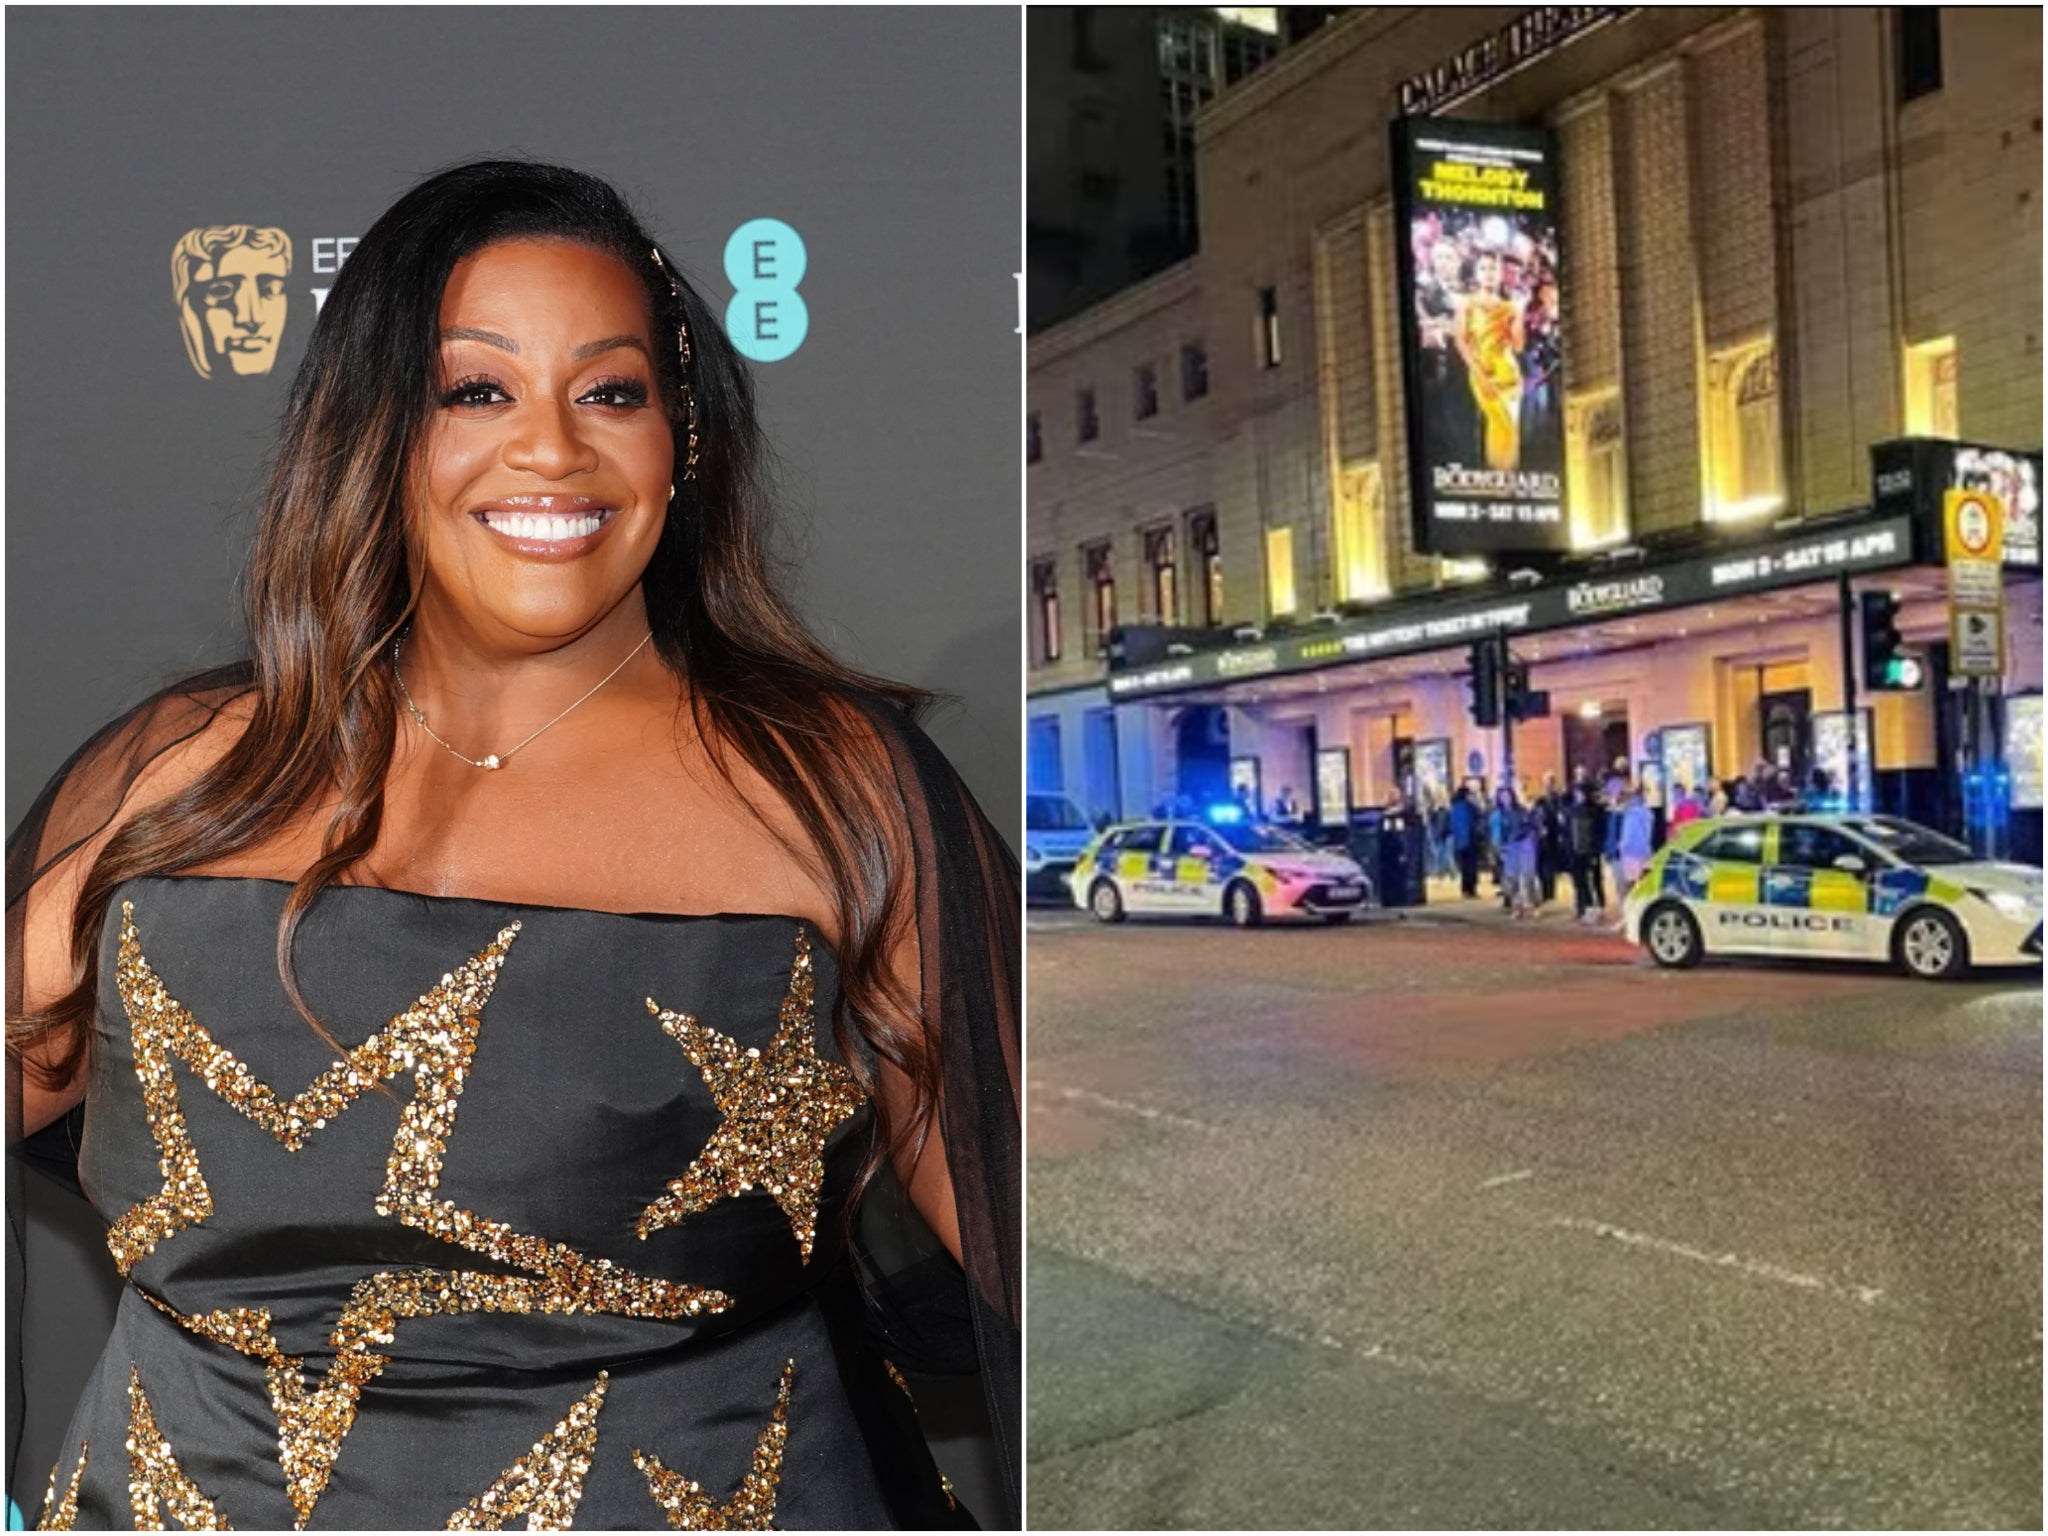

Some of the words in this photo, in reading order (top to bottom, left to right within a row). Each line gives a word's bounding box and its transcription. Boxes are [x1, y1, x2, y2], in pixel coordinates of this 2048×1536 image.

[1433, 161, 1528, 188] MELODY
[1418, 179, 1544, 209] THORNTON
[1784, 546, 1822, 571] SAT
[1851, 531, 1895, 559] APR
[1719, 911, 1852, 932] POLICE
